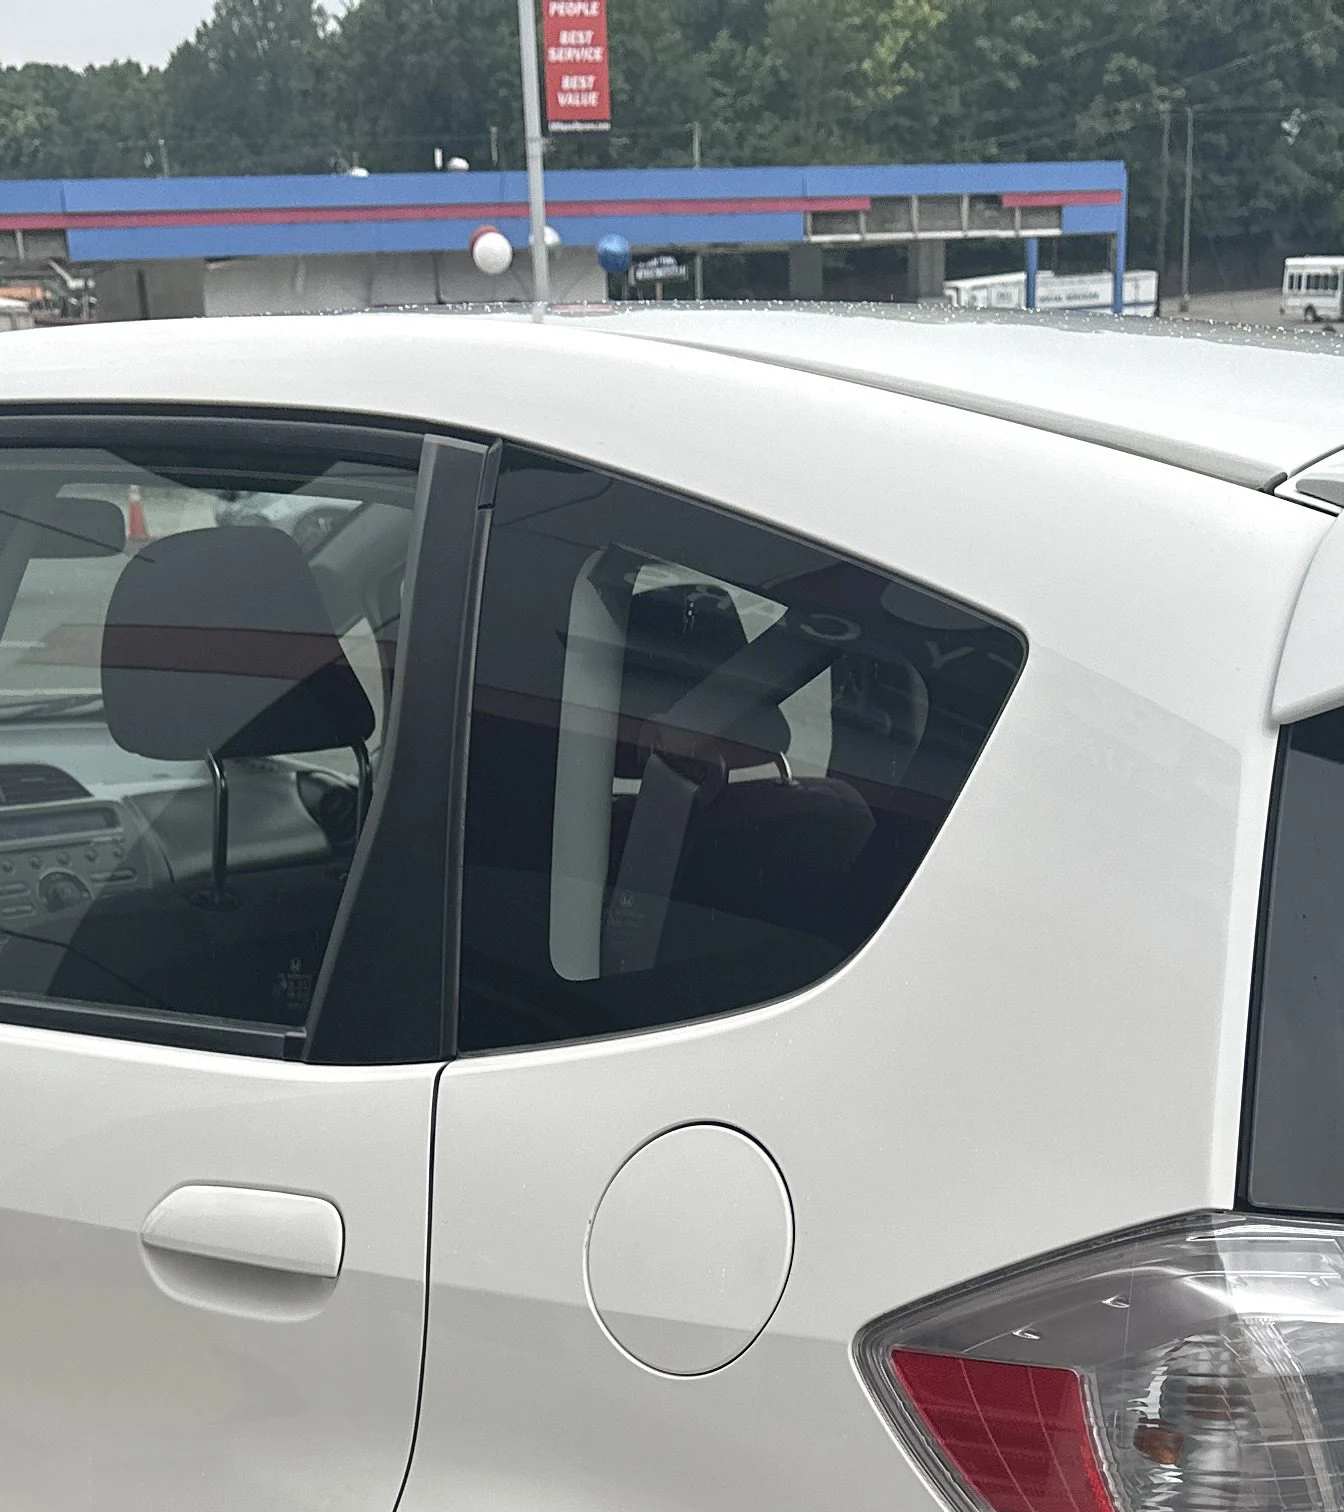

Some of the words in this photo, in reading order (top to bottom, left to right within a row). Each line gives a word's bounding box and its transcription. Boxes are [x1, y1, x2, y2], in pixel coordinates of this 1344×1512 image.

[548, 0, 600, 17] PEOPLE
[559, 30, 594, 45] BEST
[548, 47, 604, 62] SERVICE
[561, 75, 596, 90] BEST
[557, 91, 600, 107] VALUE
